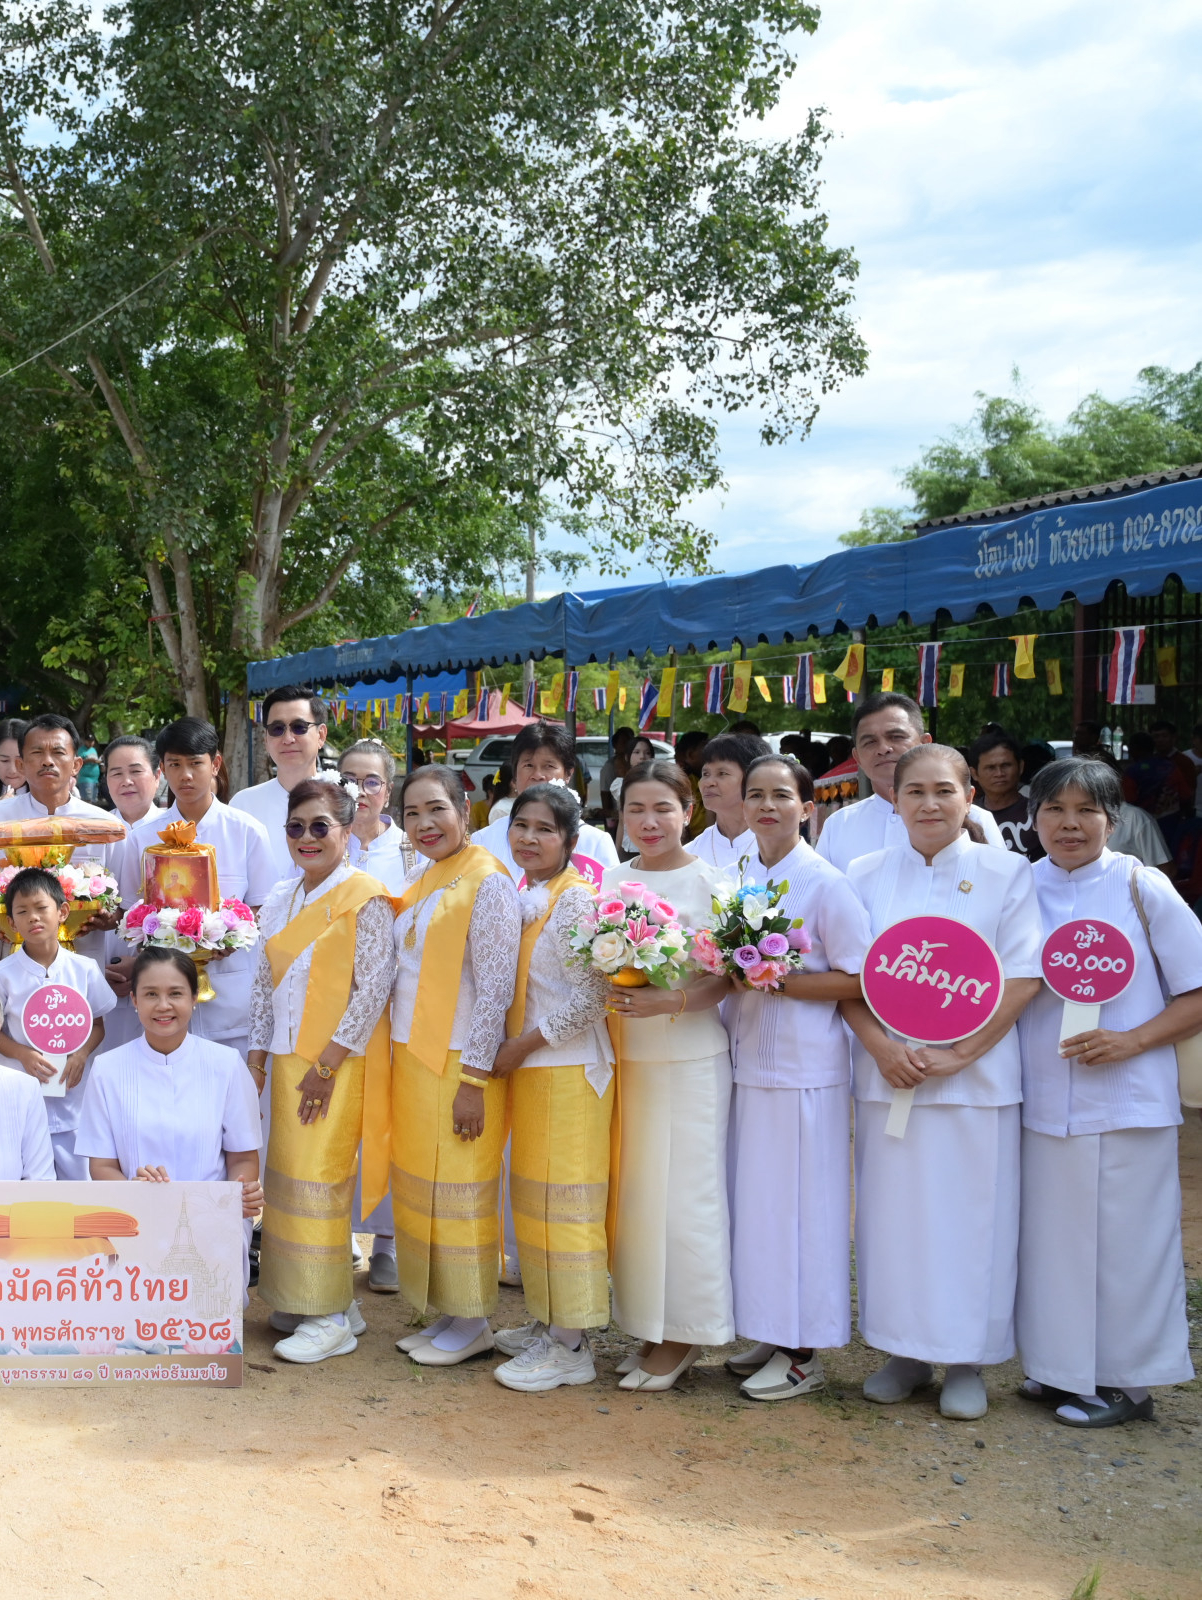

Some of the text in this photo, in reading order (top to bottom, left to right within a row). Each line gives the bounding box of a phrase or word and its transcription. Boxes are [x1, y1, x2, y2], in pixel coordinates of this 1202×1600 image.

[1074, 924, 1105, 949] กฐิน
[1049, 951, 1126, 974] 30,000
[875, 940, 992, 1009] ปลื้มบุญ
[1071, 978, 1095, 997] วัด
[45, 988, 67, 1010] กฐิน
[29, 1013, 86, 1030] 30,000
[48, 1032, 66, 1049] วัด
[12, 1319, 125, 1349] พุทธศักราช
[135, 1317, 231, 1342] ๒๕๖๘
[0, 1369, 67, 1384] บูชาธรรม
[73, 1369, 93, 1379] ๘๑
[99, 1365, 108, 1379] ปี
[114, 1364, 227, 1379] หลวงพ่อธัมมชโย
